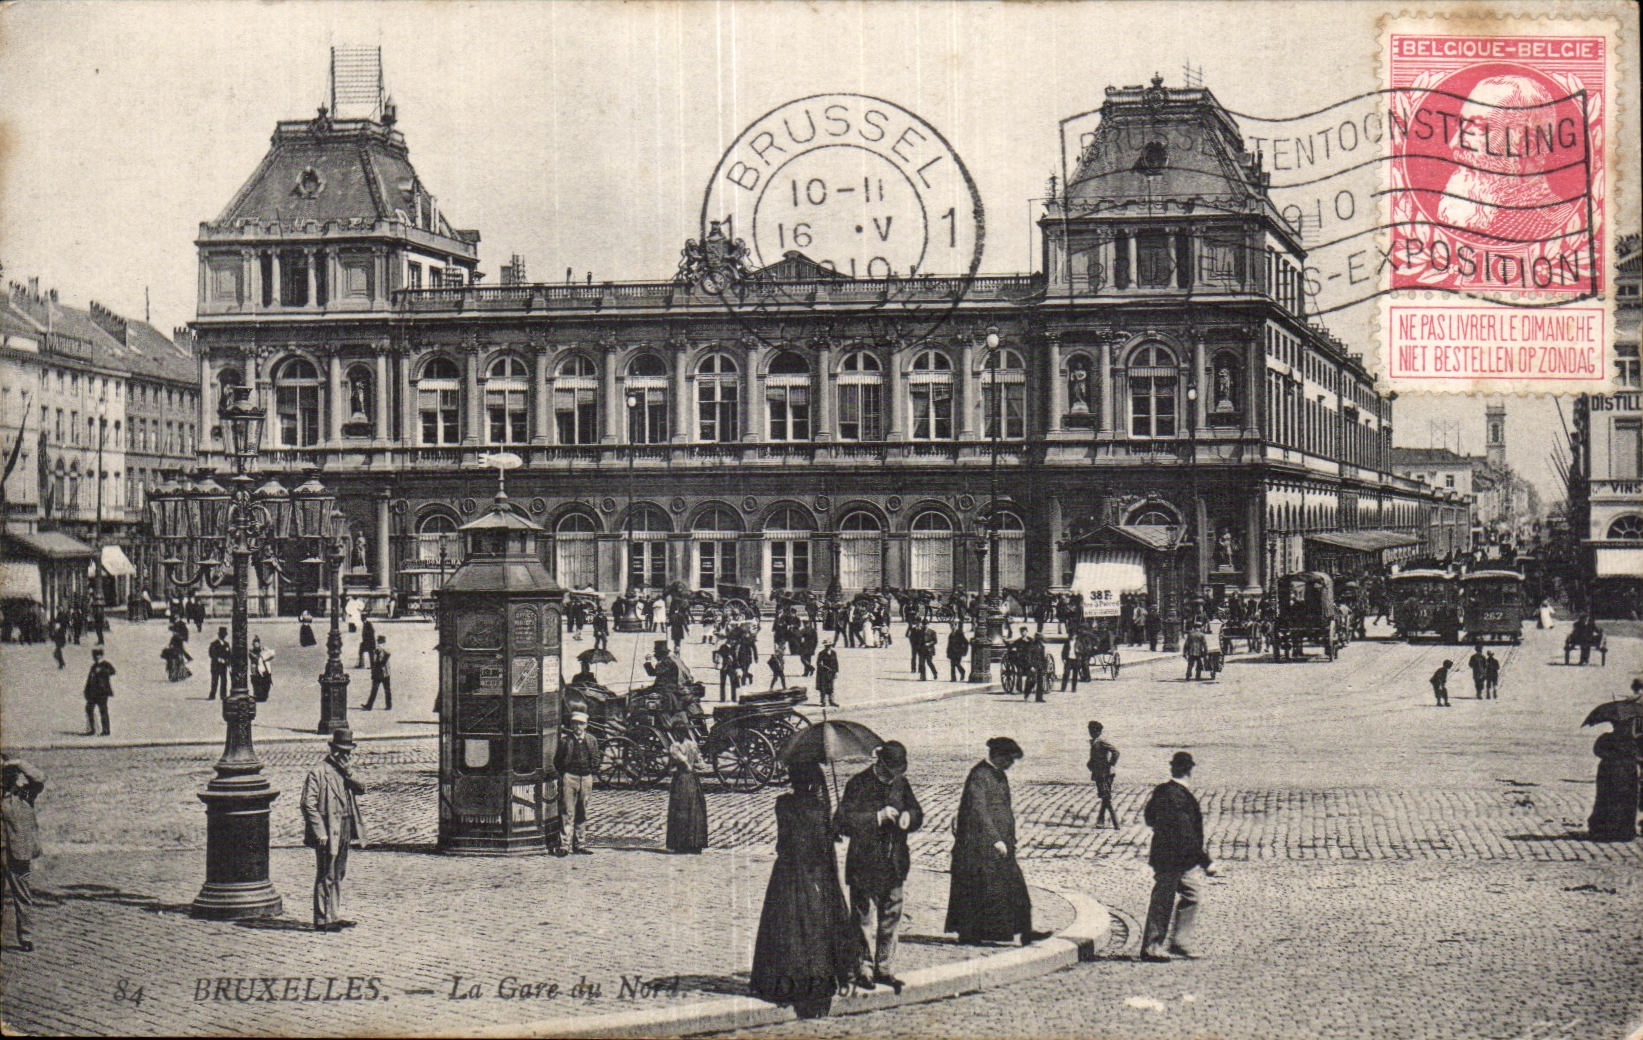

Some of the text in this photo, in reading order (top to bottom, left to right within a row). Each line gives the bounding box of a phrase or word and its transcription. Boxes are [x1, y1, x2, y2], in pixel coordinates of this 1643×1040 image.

[1399, 314, 1596, 342] NE PAS LIVRER LE DIMANCHE
[1399, 345, 1596, 374] NIET BESTELLEN OP ZONDAG
[1610, 481, 1642, 494] VINS
